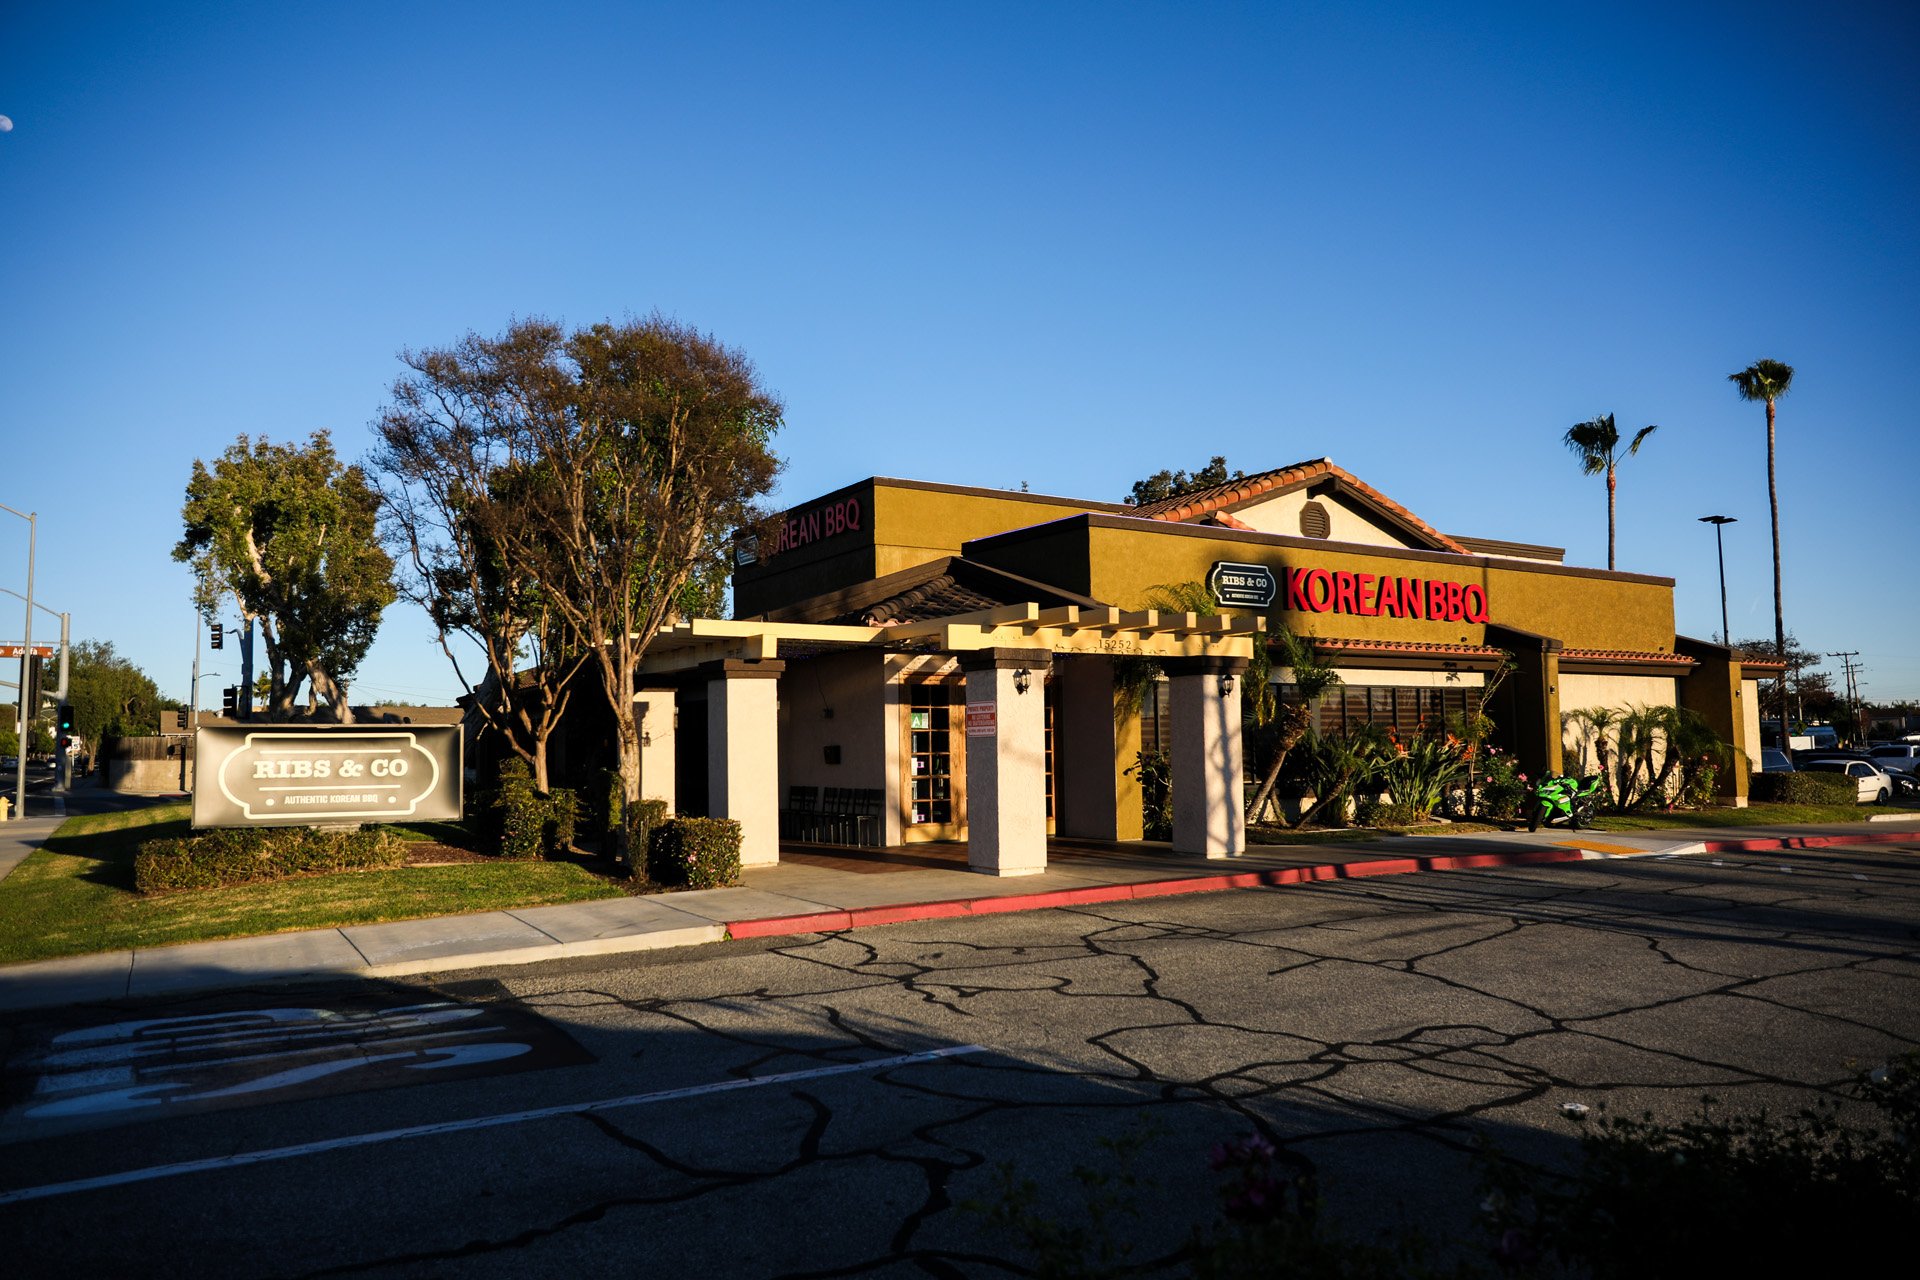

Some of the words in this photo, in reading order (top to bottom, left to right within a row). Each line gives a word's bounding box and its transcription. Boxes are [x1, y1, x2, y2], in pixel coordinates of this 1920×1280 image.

[764, 511, 820, 556] REAN
[825, 498, 860, 537] BBQ
[1221, 575, 1245, 586] RIBS
[1246, 577, 1255, 587] &
[1255, 578, 1268, 588] CO
[1284, 566, 1423, 619] KOREAN
[1427, 580, 1490, 624] BBQ
[1098, 639, 1132, 650] 15252
[13, 647, 38, 655] Adfa
[912, 716, 921, 727] A
[252, 760, 331, 779] RIBS
[338, 759, 364, 778] &
[370, 758, 409, 777] CO
[284, 795, 328, 805] AUTHENTIC
[329, 794, 361, 804] KOREAN
